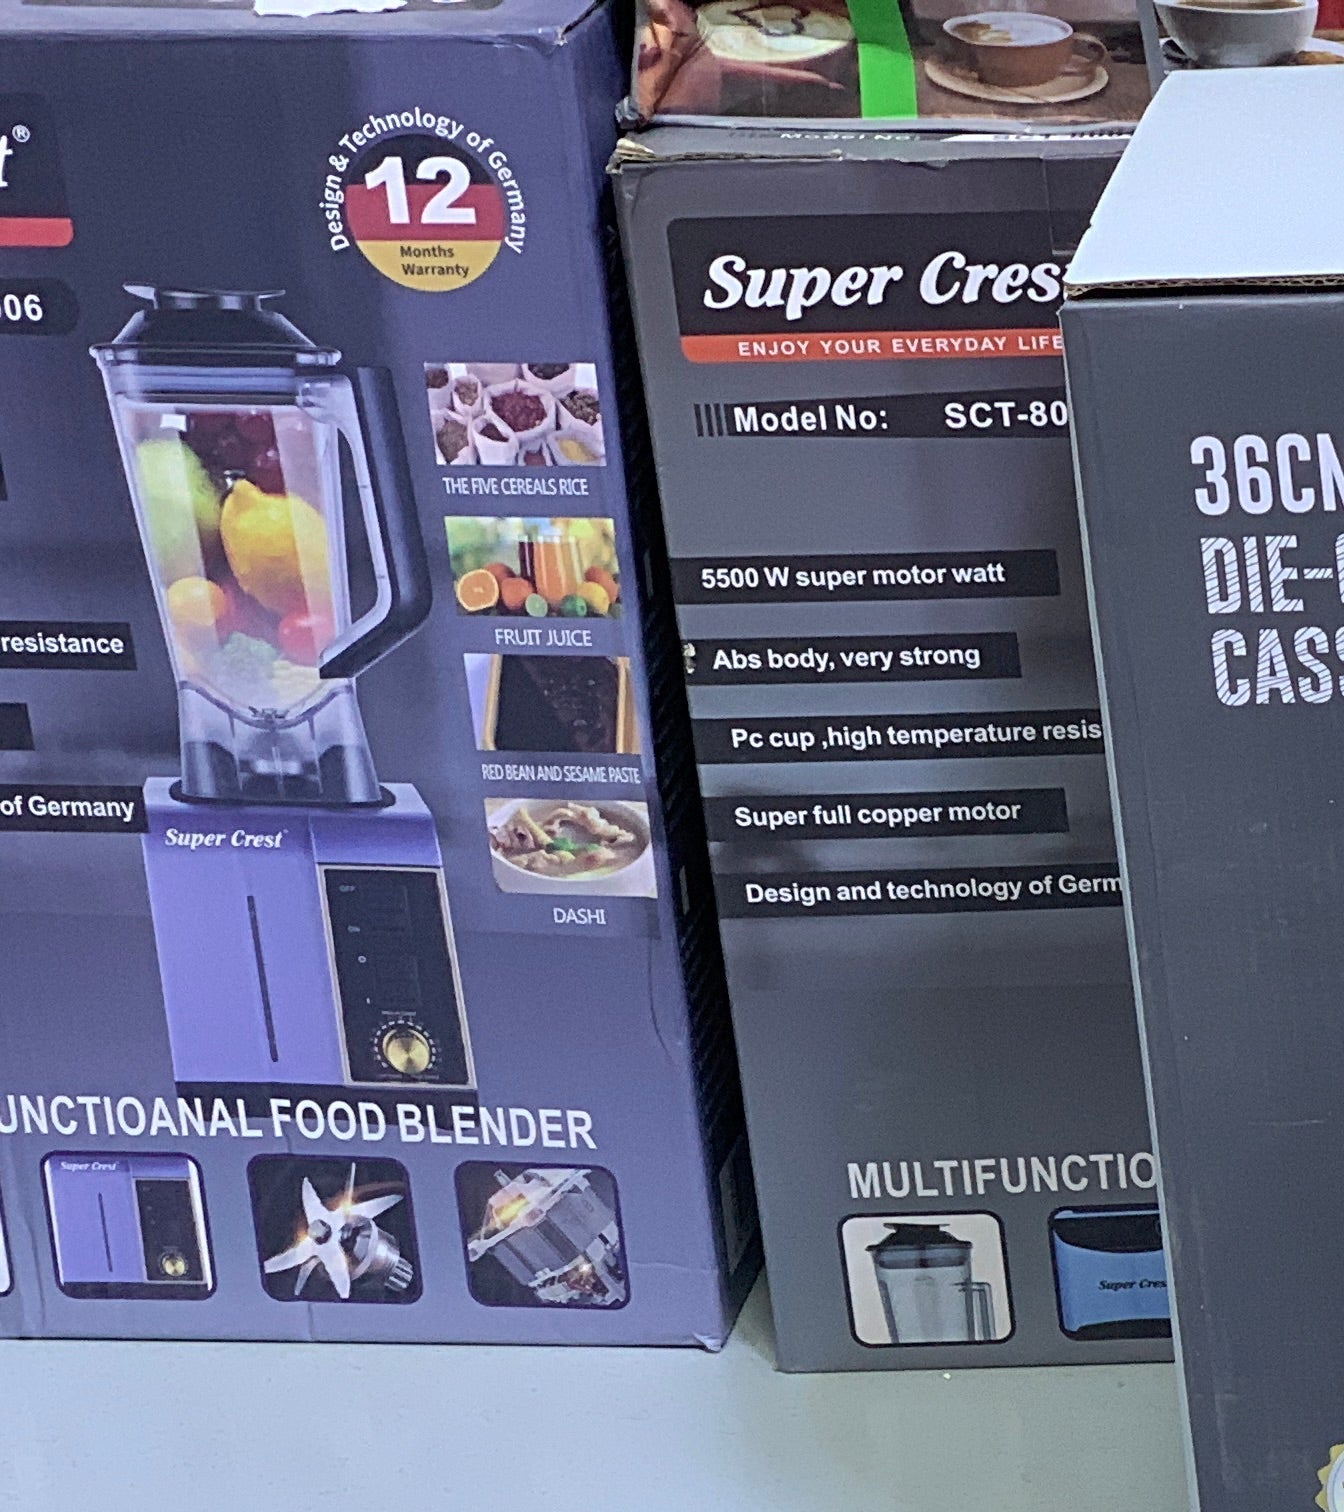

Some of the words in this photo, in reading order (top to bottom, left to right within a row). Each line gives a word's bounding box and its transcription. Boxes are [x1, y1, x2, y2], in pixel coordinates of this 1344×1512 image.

[338, 107, 464, 153] Technology
[466, 131, 495, 153] of
[329, 154, 349, 172] &
[364, 156, 477, 224] 12
[488, 151, 526, 254] Germany
[319, 174, 350, 251] Design
[400, 246, 455, 258] Months
[401, 263, 470, 278] Warranty
[703, 254, 903, 321] Super
[919, 250, 1067, 305] Cres
[0, 293, 43, 321] 06
[738, 341, 809, 357] ENJOY
[819, 339, 881, 355] YOUR
[892, 336, 1007, 354] EVERYDAY
[1018, 335, 1063, 351] LIFE
[733, 404, 826, 432] Model
[836, 404, 889, 431] No:
[944, 400, 1067, 429] SCT-80
[442, 477, 469, 494] THE
[471, 477, 499, 495] FIVE
[500, 478, 557, 495] CEREALS
[559, 478, 589, 496] RICE
[701, 568, 759, 589] 5500
[763, 567, 790, 587] W
[795, 568, 867, 591] super
[873, 566, 947, 586] motor
[952, 563, 1006, 584] watt
[1, 632, 124, 655] resistance
[495, 628, 542, 646] FRUIT
[546, 629, 593, 647] JUICE
[713, 649, 761, 670] Abs
[767, 647, 835, 672] body,
[840, 649, 893, 672] very
[899, 645, 981, 669] strong
[731, 727, 764, 748] Pc
[769, 730, 815, 751] cup
[887, 723, 1036, 748] temperature
[1043, 719, 1101, 739] resis
[482, 764, 504, 780] RED
[506, 765, 535, 781] BEAN
[536, 765, 563, 781] AND
[564, 765, 606, 783] SESAME
[609, 766, 641, 784] PASTE
[0, 795, 23, 816] of
[28, 796, 135, 822] Germany
[735, 807, 807, 830] Super
[812, 805, 851, 825] full
[857, 806, 942, 827] copper
[948, 802, 1021, 821] motor
[165, 828, 226, 850] Super
[231, 829, 282, 849] Crest
[745, 882, 831, 906] Design
[836, 881, 882, 901] and
[886, 878, 1022, 901] technology
[1029, 875, 1052, 894] of
[1058, 874, 1123, 893] Germ
[553, 908, 606, 925] DASHI
[270, 1098, 386, 1141] FOOD
[397, 1103, 598, 1149] BLENDER
[60, 1161, 90, 1172] Super
[91, 1162, 117, 1171] Crest
[847, 1152, 1157, 1199] MULTIFUNCTIO
[1099, 1280, 1136, 1291] Super
